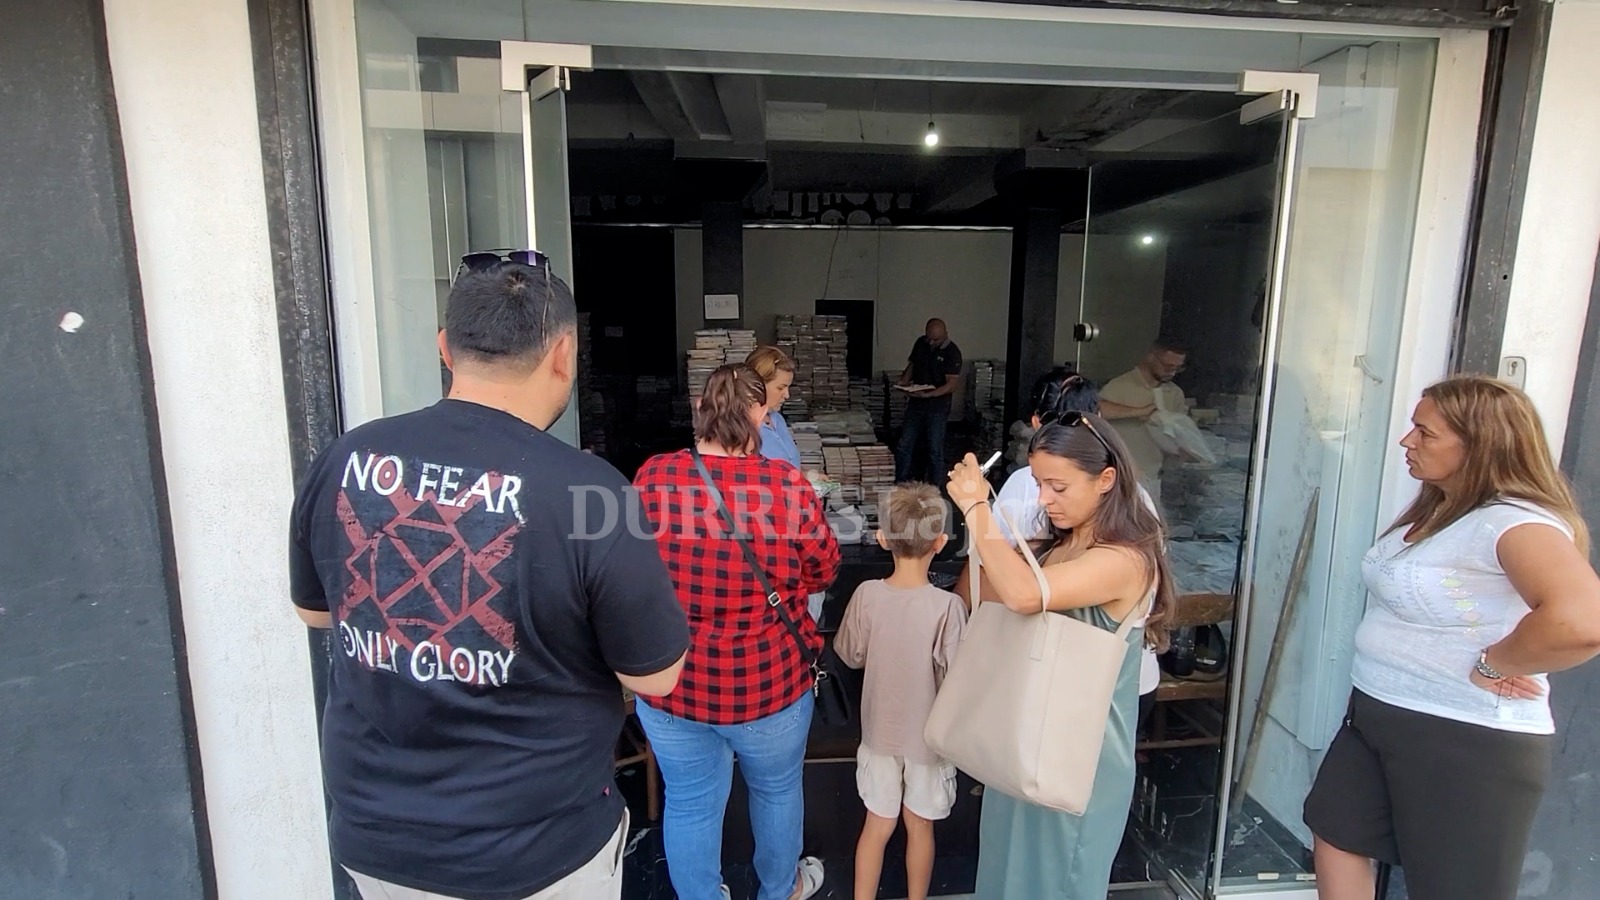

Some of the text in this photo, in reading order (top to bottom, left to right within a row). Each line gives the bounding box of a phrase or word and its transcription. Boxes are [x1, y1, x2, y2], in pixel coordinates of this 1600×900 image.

[341, 451, 526, 525] NO FEAR
[339, 620, 515, 687] ONLY GLORY
